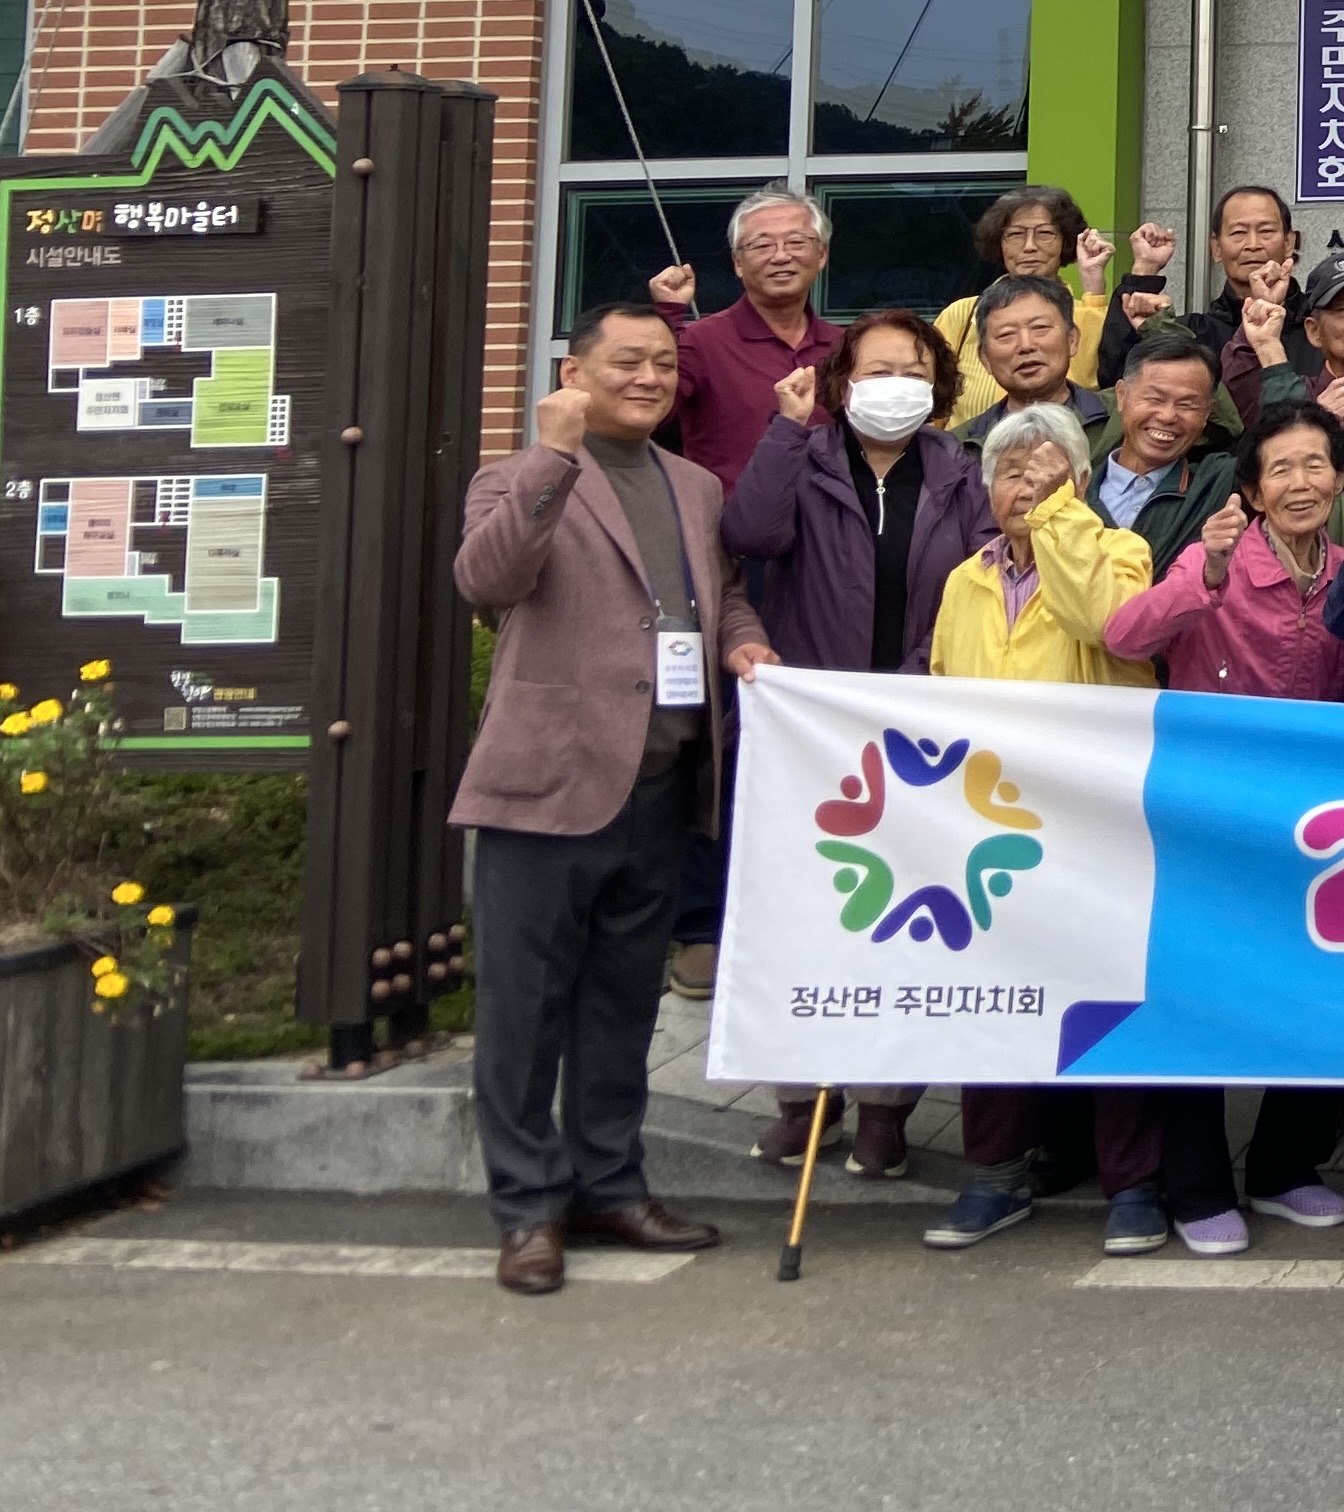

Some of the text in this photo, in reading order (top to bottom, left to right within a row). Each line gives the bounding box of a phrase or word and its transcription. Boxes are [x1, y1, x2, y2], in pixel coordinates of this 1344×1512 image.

[113, 200, 240, 234] 행복마을터
[25, 245, 123, 268] 시설안내도
[14, 306, 43, 327] 1층
[790, 984, 1045, 1019] 정산면 주민자치회
